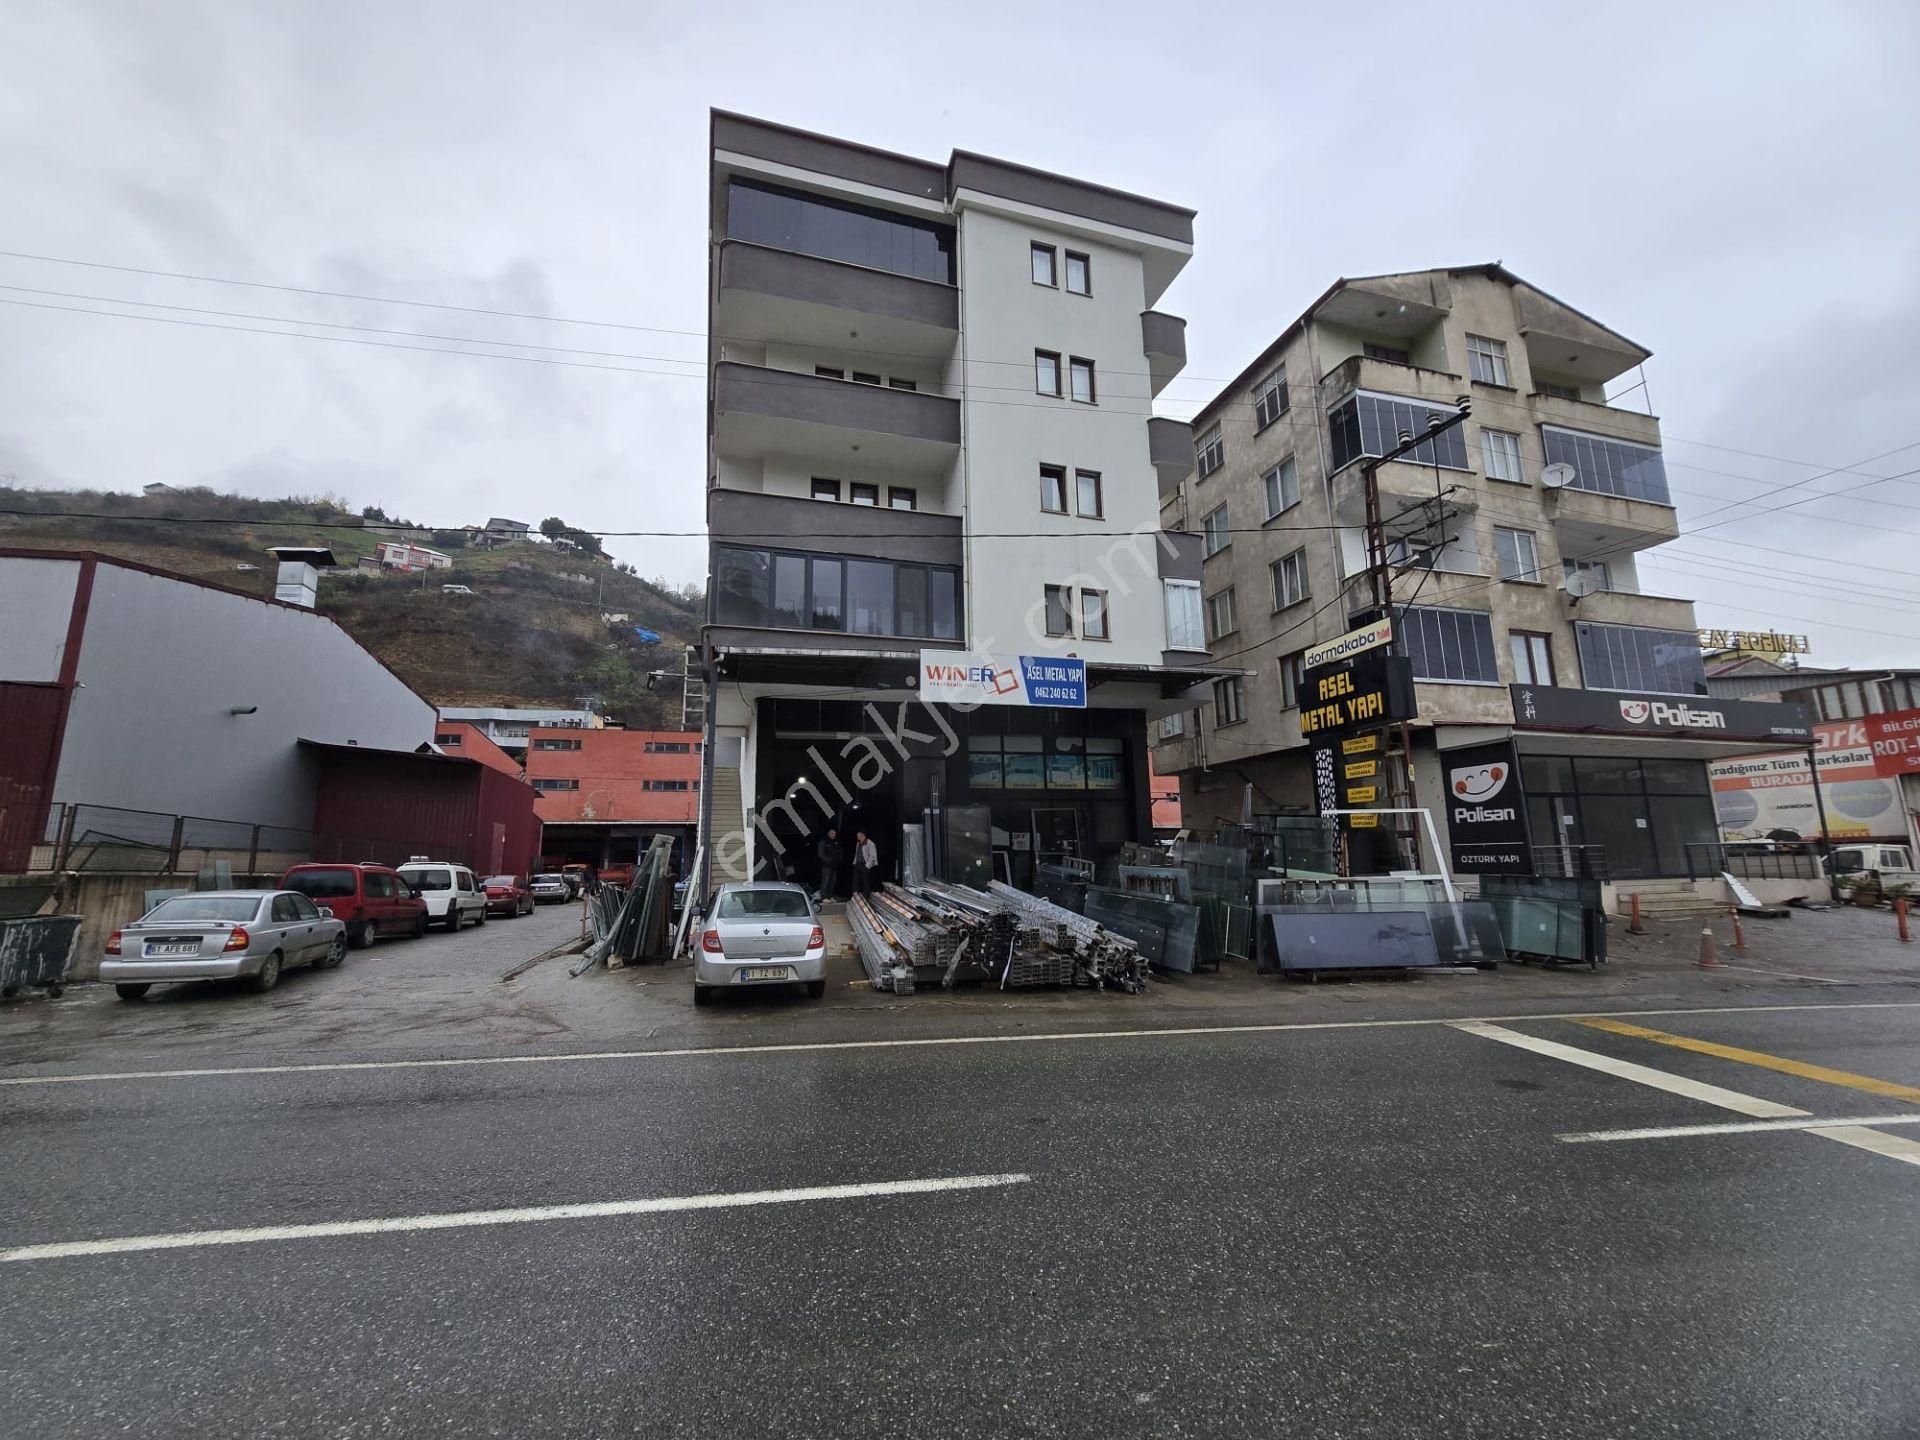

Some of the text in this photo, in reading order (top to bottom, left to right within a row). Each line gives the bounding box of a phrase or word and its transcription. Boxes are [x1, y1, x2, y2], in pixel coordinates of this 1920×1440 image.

[1307, 631, 1376, 666] dormakaba
[926, 664, 994, 682] WINER
[1027, 666, 1083, 682] ASEL METAL YAPI
[1035, 687, 1077, 699] 0462 240 62 62
[1319, 671, 1355, 701] ASEL
[1300, 691, 1384, 733] METAL YAPI
[1651, 702, 1726, 729] Polisan
[1770, 760, 1800, 771] Tüm
[1454, 805, 1516, 824] Polisan
[1498, 854, 1520, 863] YAPI
